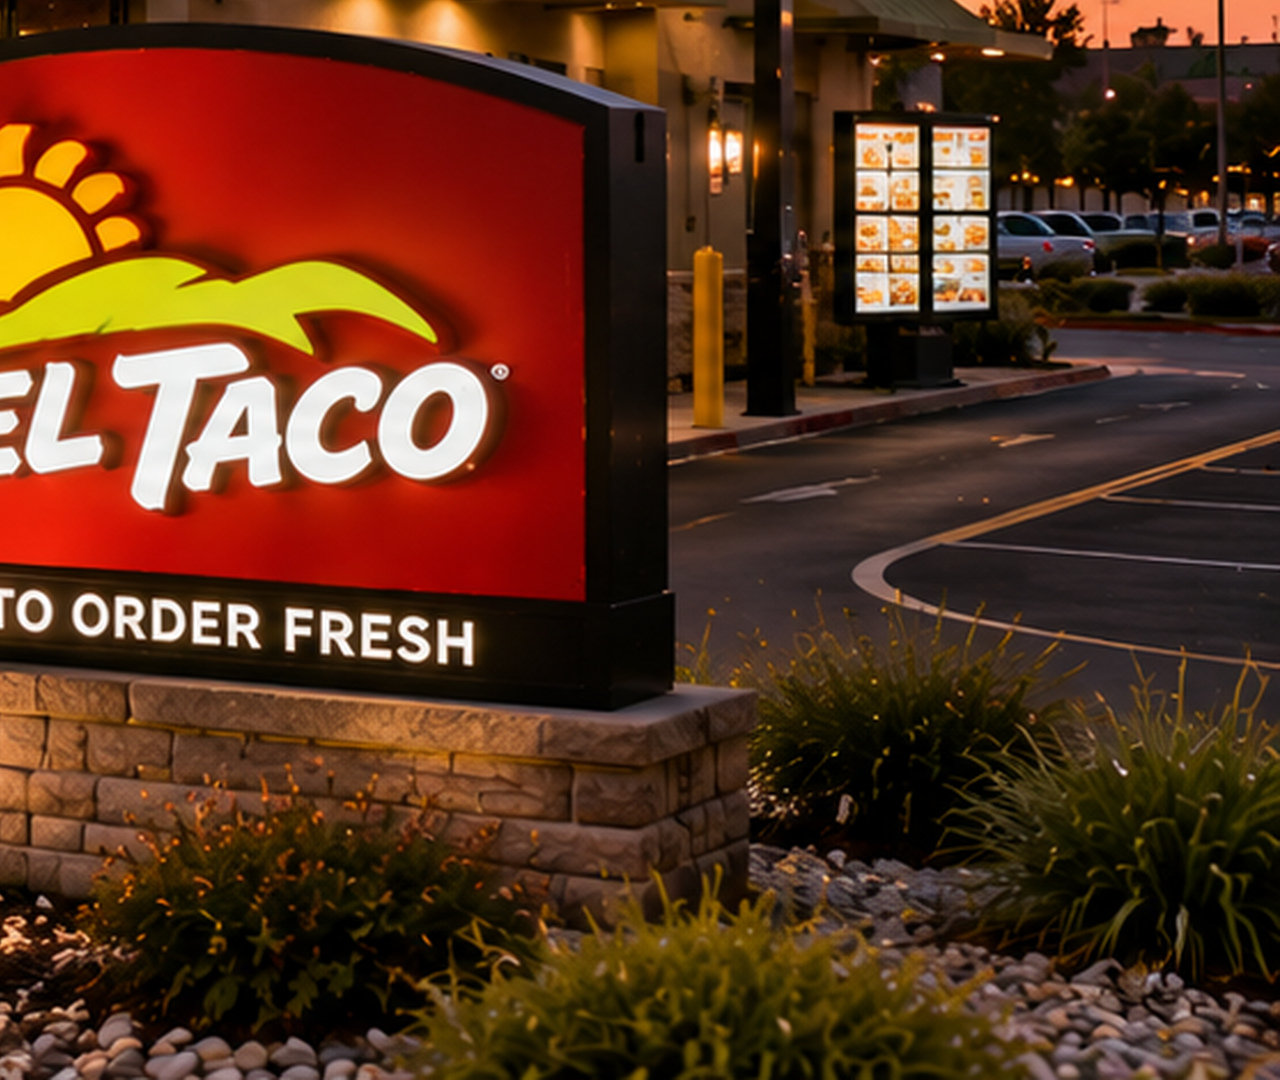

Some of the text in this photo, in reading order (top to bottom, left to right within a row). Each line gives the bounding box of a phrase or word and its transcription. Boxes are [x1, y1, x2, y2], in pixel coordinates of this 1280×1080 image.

[111, 342, 489, 511] TACO
[71, 593, 262, 649] ORDER
[284, 607, 475, 667] FRESH
